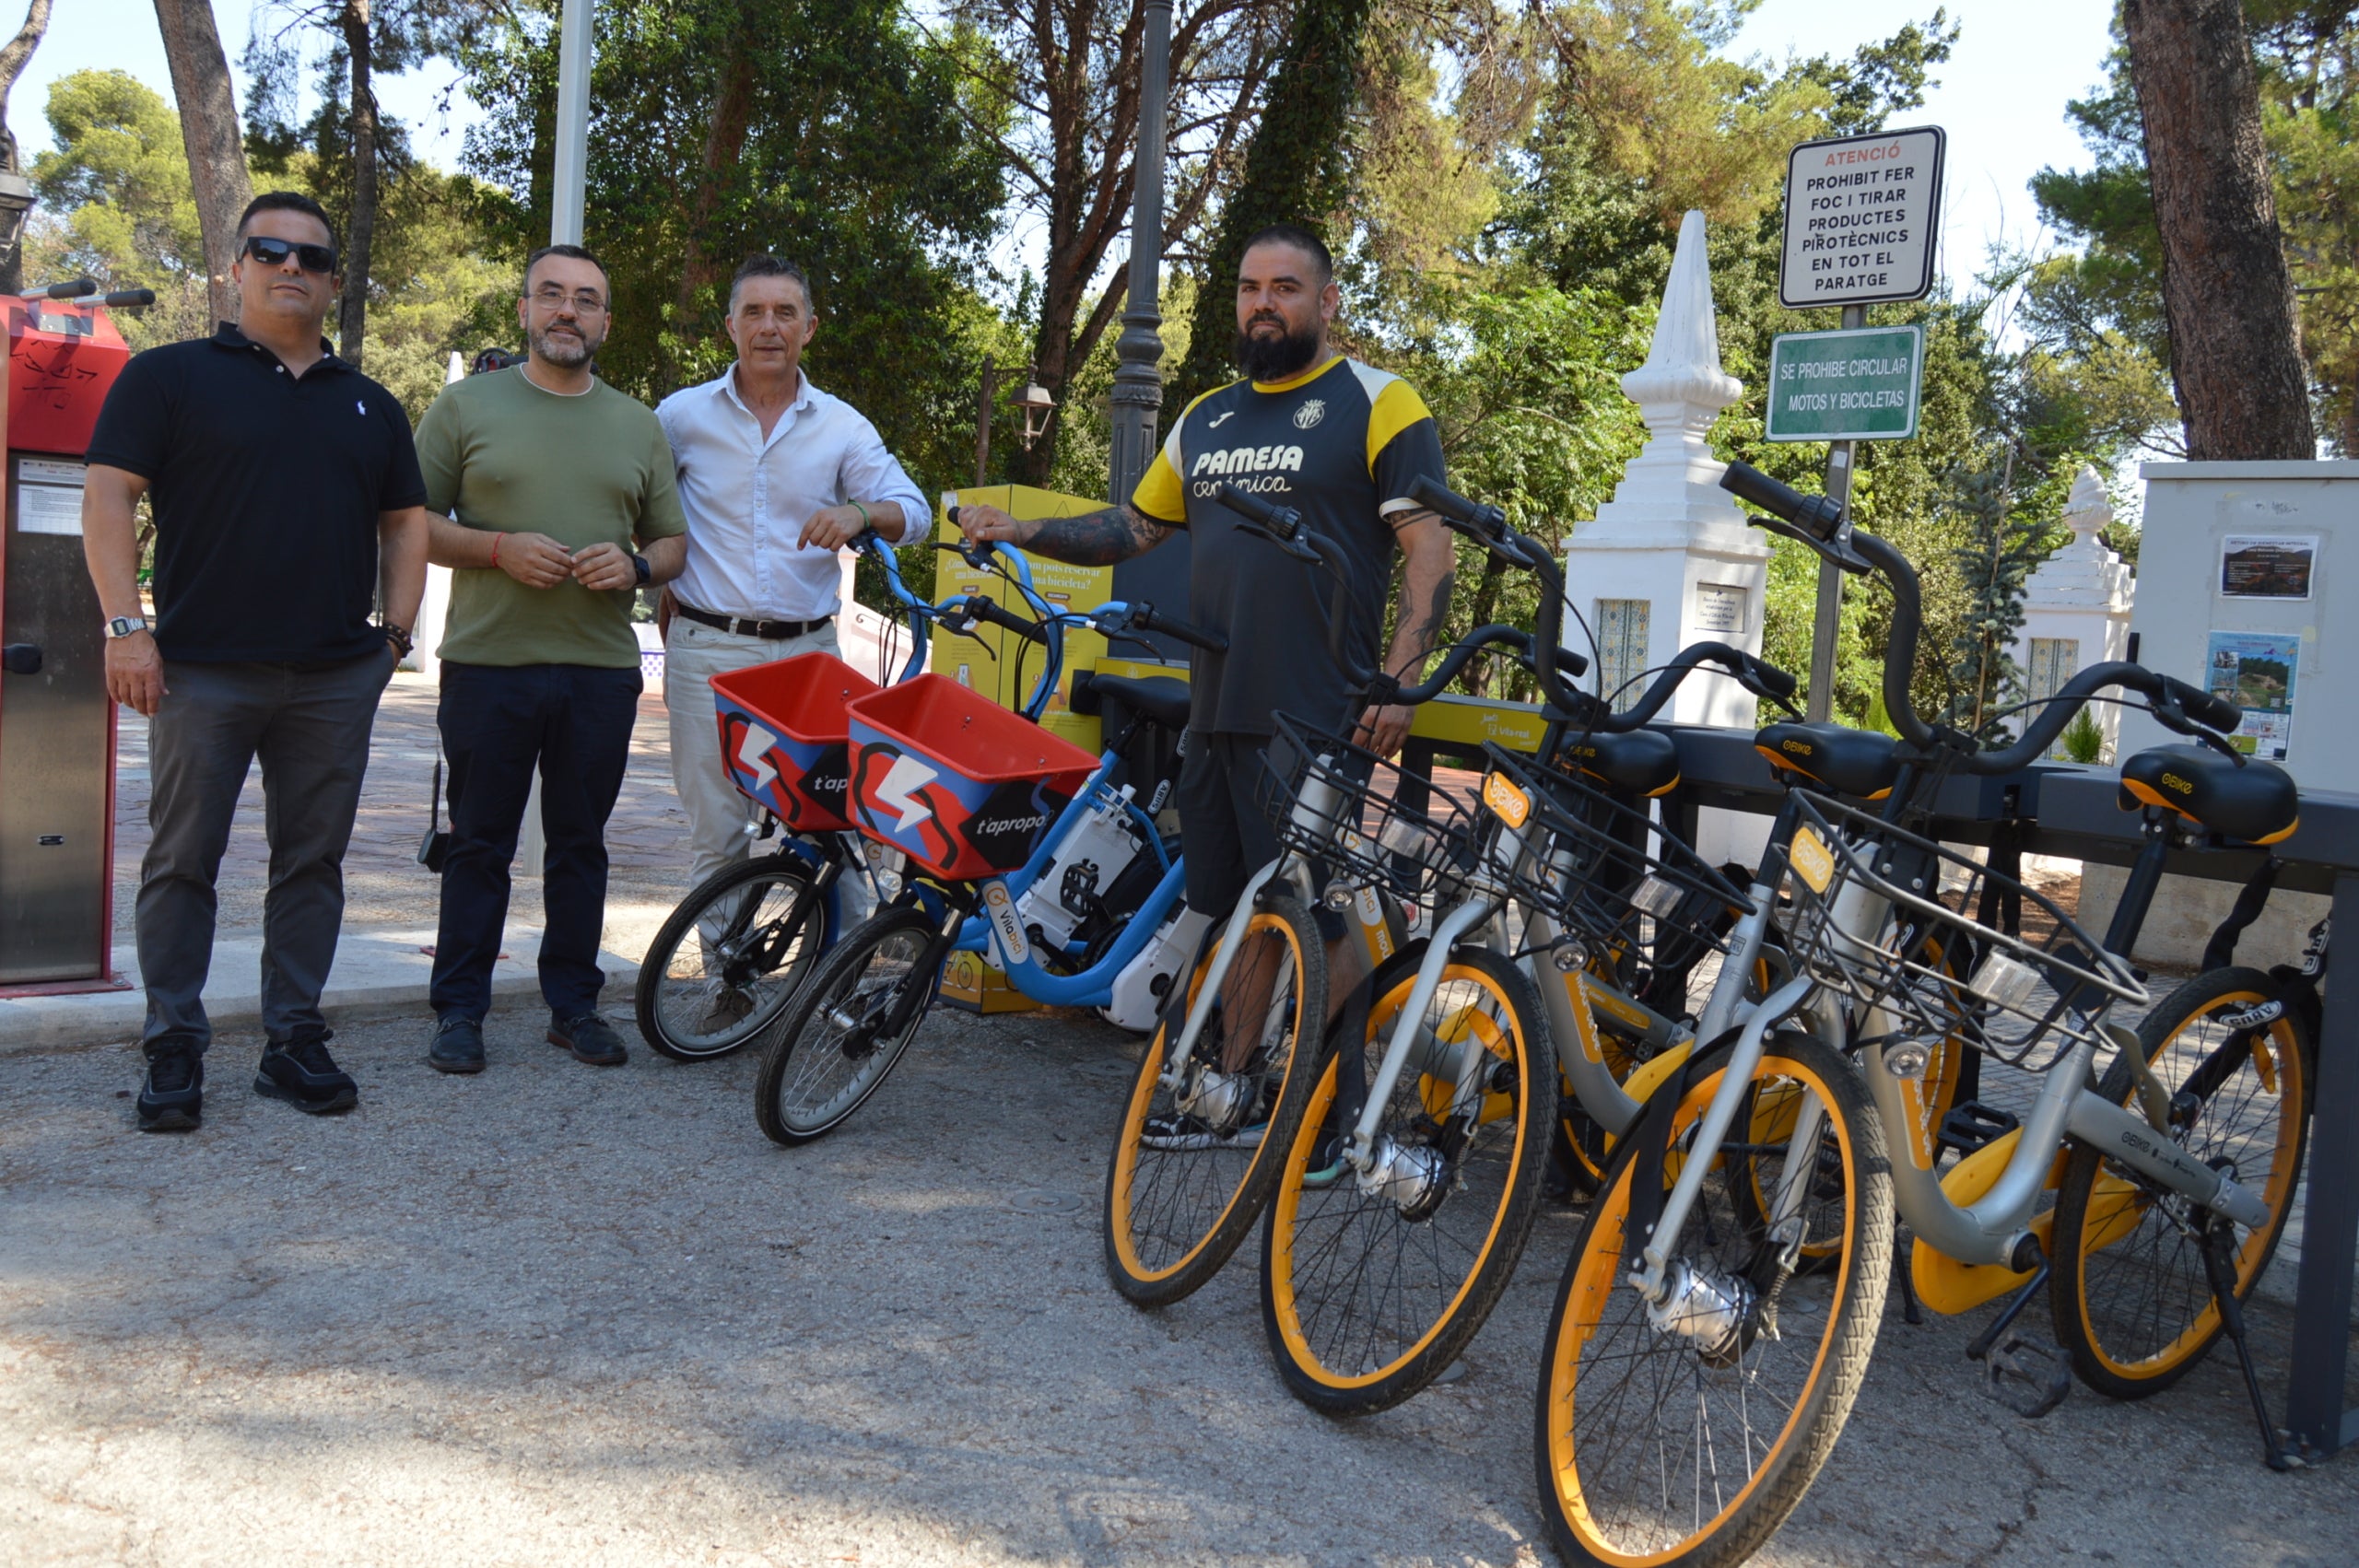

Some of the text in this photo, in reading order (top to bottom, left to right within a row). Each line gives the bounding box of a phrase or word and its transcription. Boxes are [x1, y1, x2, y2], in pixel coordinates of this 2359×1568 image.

[1825, 140, 1901, 167] ATENCIÓ
[1806, 167, 1915, 192] PROHIBIT FER
[1811, 188, 1907, 211] FOC I TIRAR
[1808, 209, 1906, 231] PRODUCTES
[1812, 252, 1895, 272] EN TOT EL
[1814, 273, 1888, 292] PARATGE
[1780, 357, 1908, 380] SE PROHIBE CIRCULAR
[1788, 390, 1905, 412] MOTOS Y BICICLETAS
[1191, 445, 1304, 476] PAMESA
[999, 909, 1026, 954] Vilabici
[2230, 1005, 2273, 1025] ABUS
